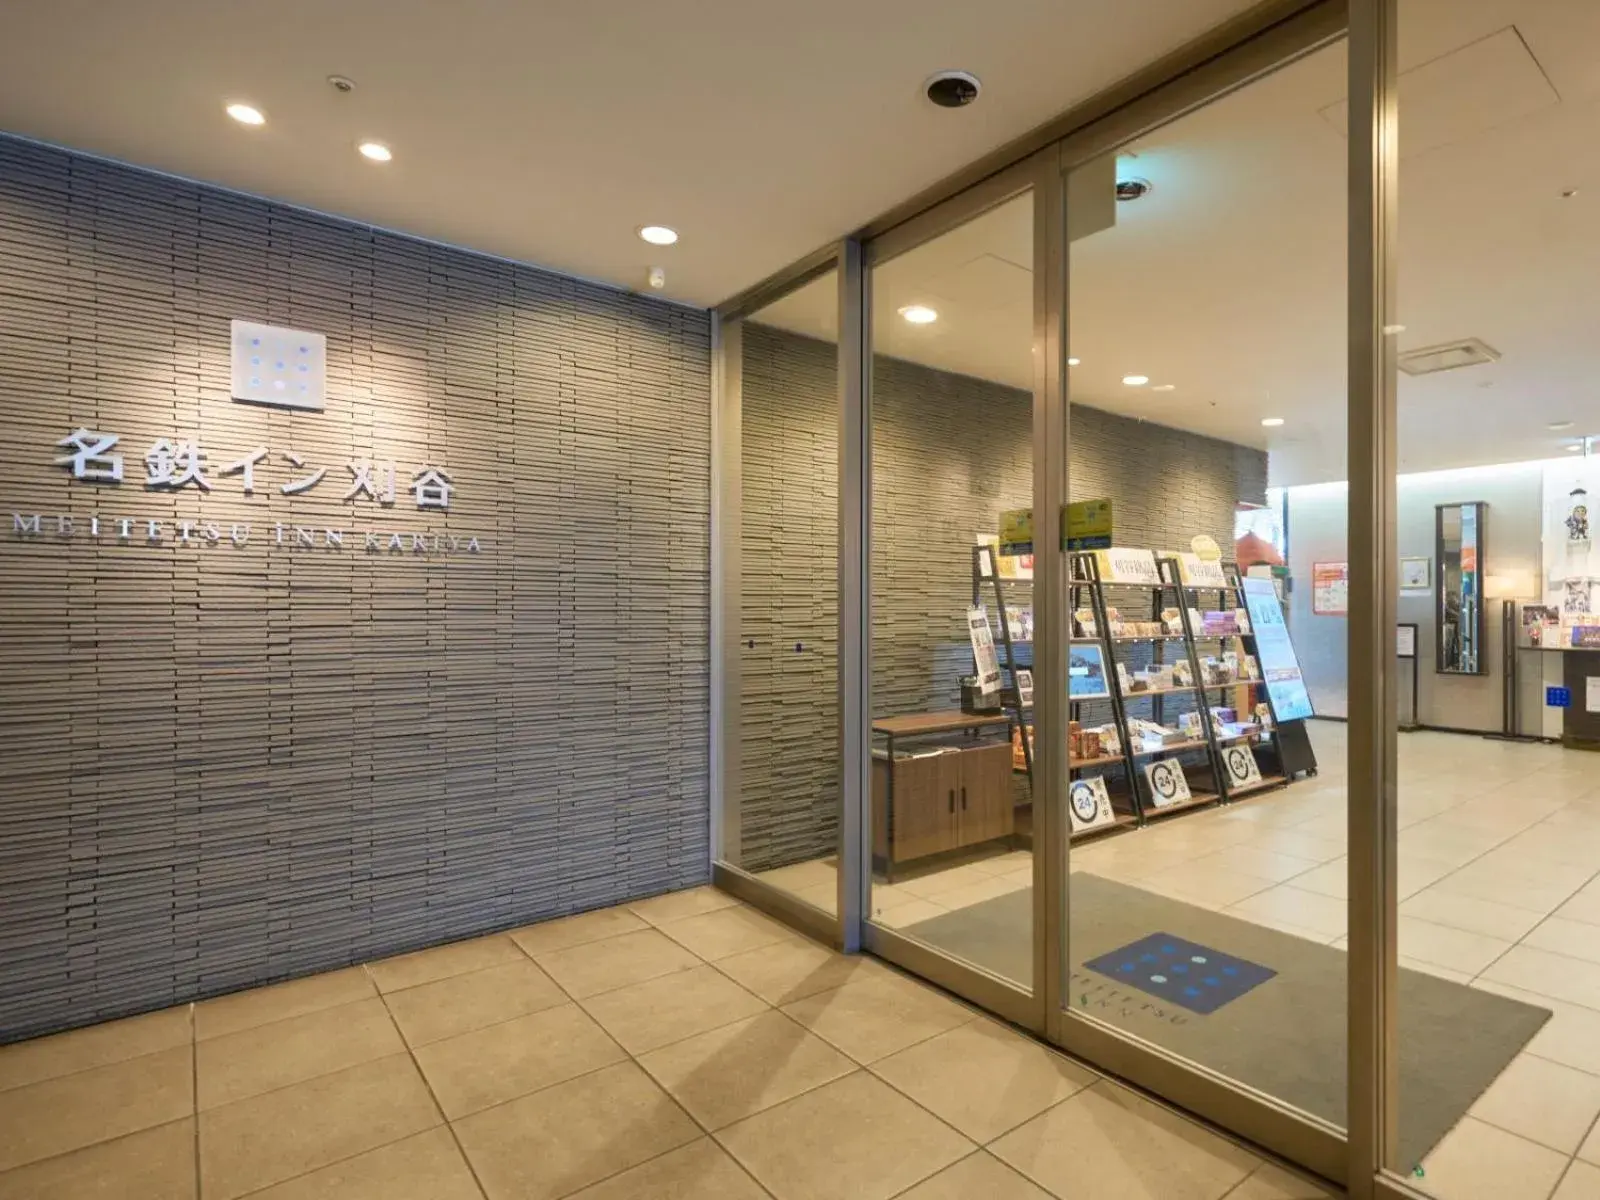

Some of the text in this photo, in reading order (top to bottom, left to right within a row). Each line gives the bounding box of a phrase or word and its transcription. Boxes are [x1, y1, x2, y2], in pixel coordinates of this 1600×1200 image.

[12, 511, 482, 552] MEITETSU INN KARIYA
[1233, 759, 1244, 770] 24
[1157, 775, 1171, 788] 24
[1077, 796, 1091, 810] 24
